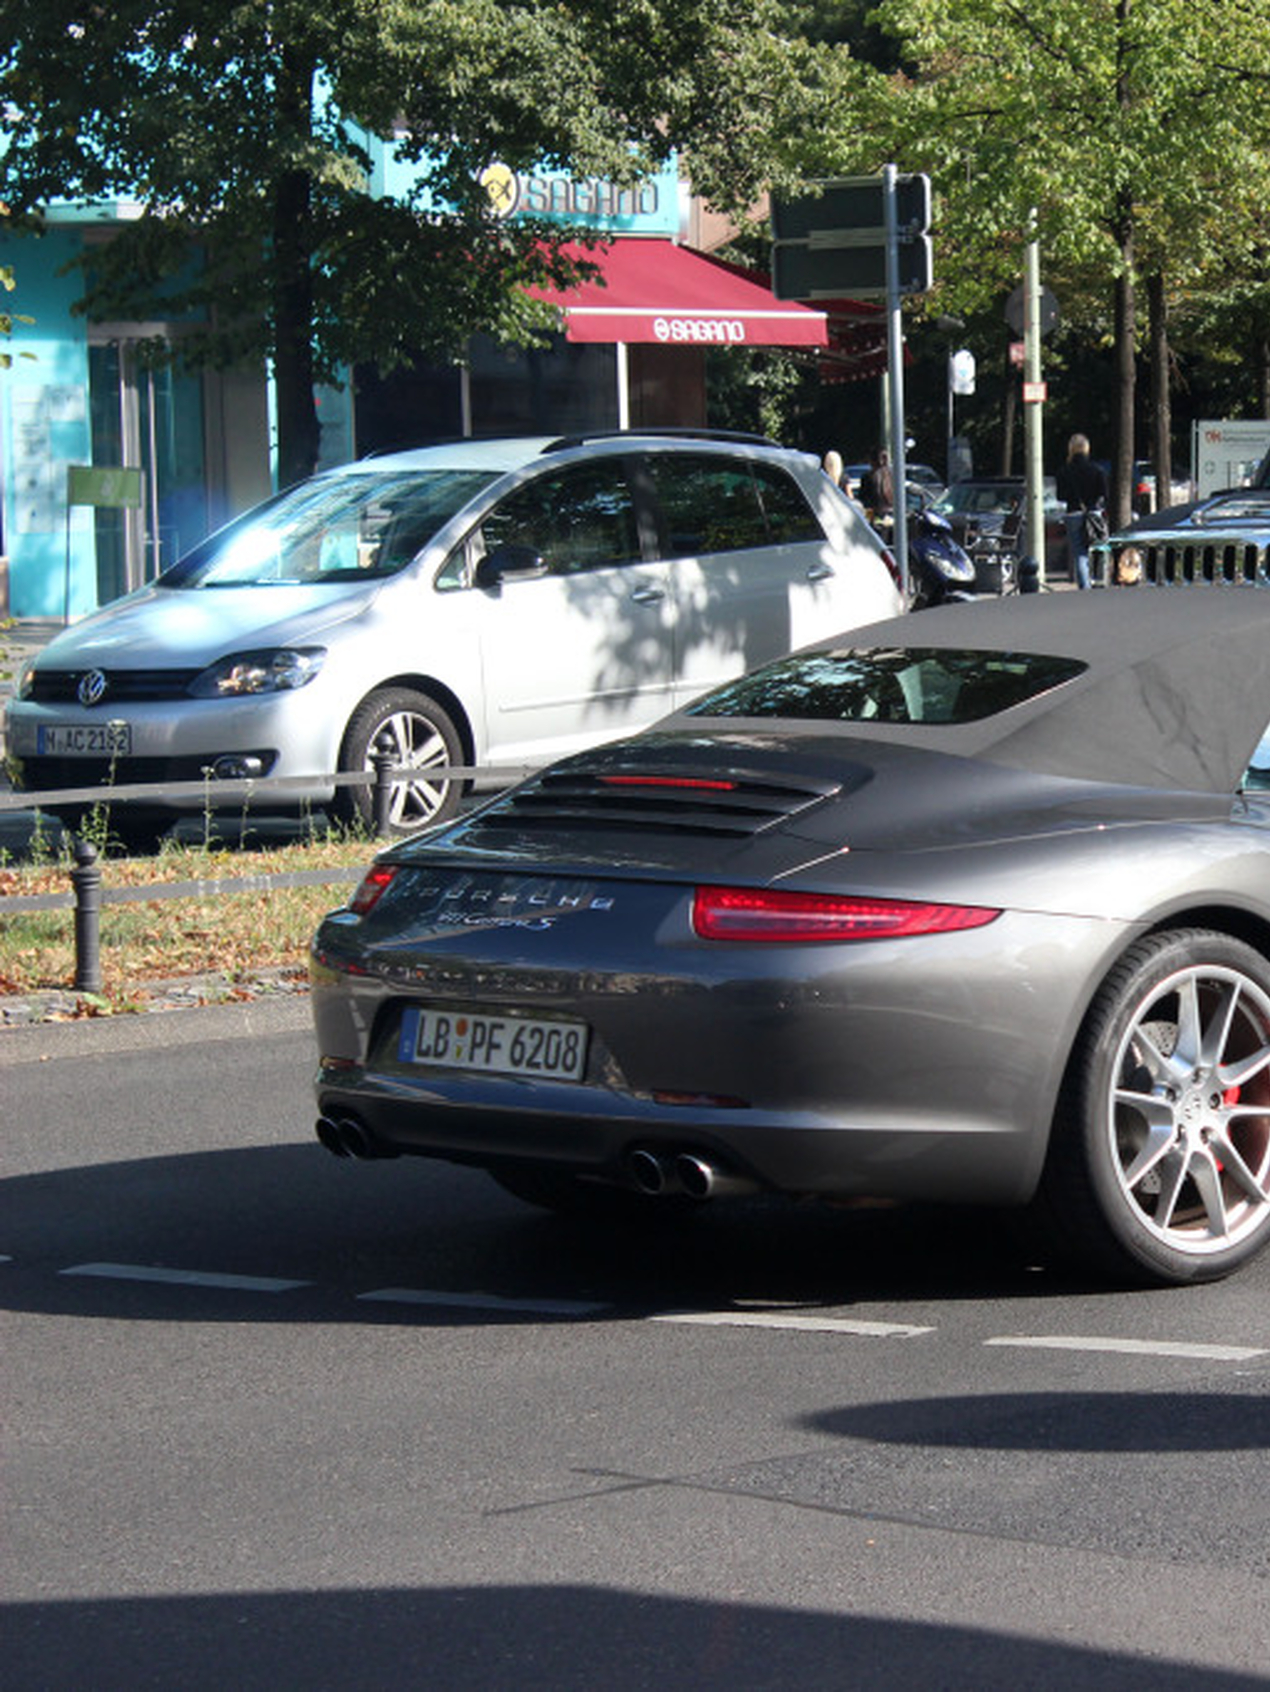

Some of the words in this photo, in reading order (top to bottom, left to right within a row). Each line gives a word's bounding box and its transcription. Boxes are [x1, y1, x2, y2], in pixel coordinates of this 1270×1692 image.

[526, 175, 659, 215] SAGANO
[670, 318, 746, 342] SAGANO
[420, 886, 615, 910] PORSCHE
[415, 1015, 450, 1058] LB
[468, 1020, 505, 1064] PF
[510, 1025, 579, 1072] 6208
